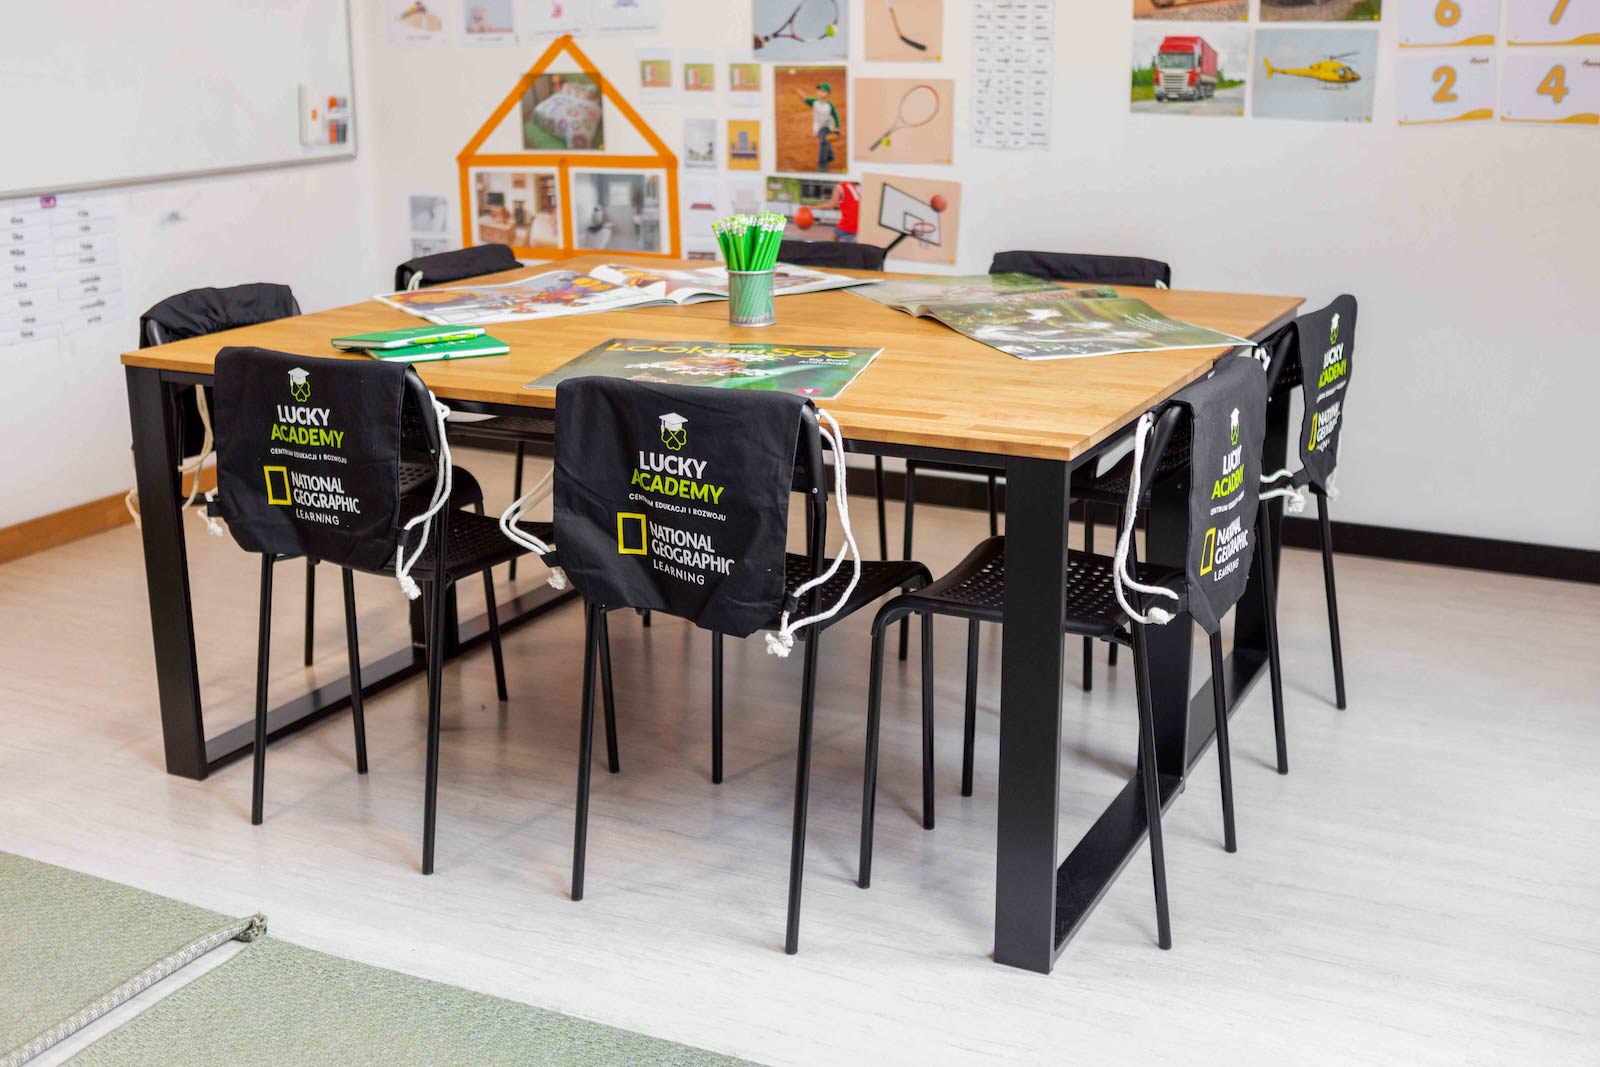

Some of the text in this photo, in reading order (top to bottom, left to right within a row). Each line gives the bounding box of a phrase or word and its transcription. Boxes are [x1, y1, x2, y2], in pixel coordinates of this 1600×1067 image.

[1434, 0, 1461, 27] 6
[1432, 65, 1457, 104] 2
[1536, 64, 1569, 104] 4
[605, 342, 708, 354] Look
[767, 347, 857, 358] See
[276, 404, 330, 426] LUCKY
[270, 423, 345, 449] ACADEMY
[323, 453, 348, 464] ROZWOJU
[638, 450, 708, 480] LUCKY
[290, 470, 345, 494] NATIONAL
[631, 468, 724, 504] ACADEMY
[293, 488, 361, 514] GEOGRAPHIC
[654, 500, 687, 514] EDUKACJI
[692, 507, 727, 522] ROZWOJU
[295, 508, 340, 526] LEARNING
[649, 520, 716, 553] NATIONAL
[651, 539, 736, 576] GEOGRAPHIC
[652, 558, 706, 586] LEARNING
